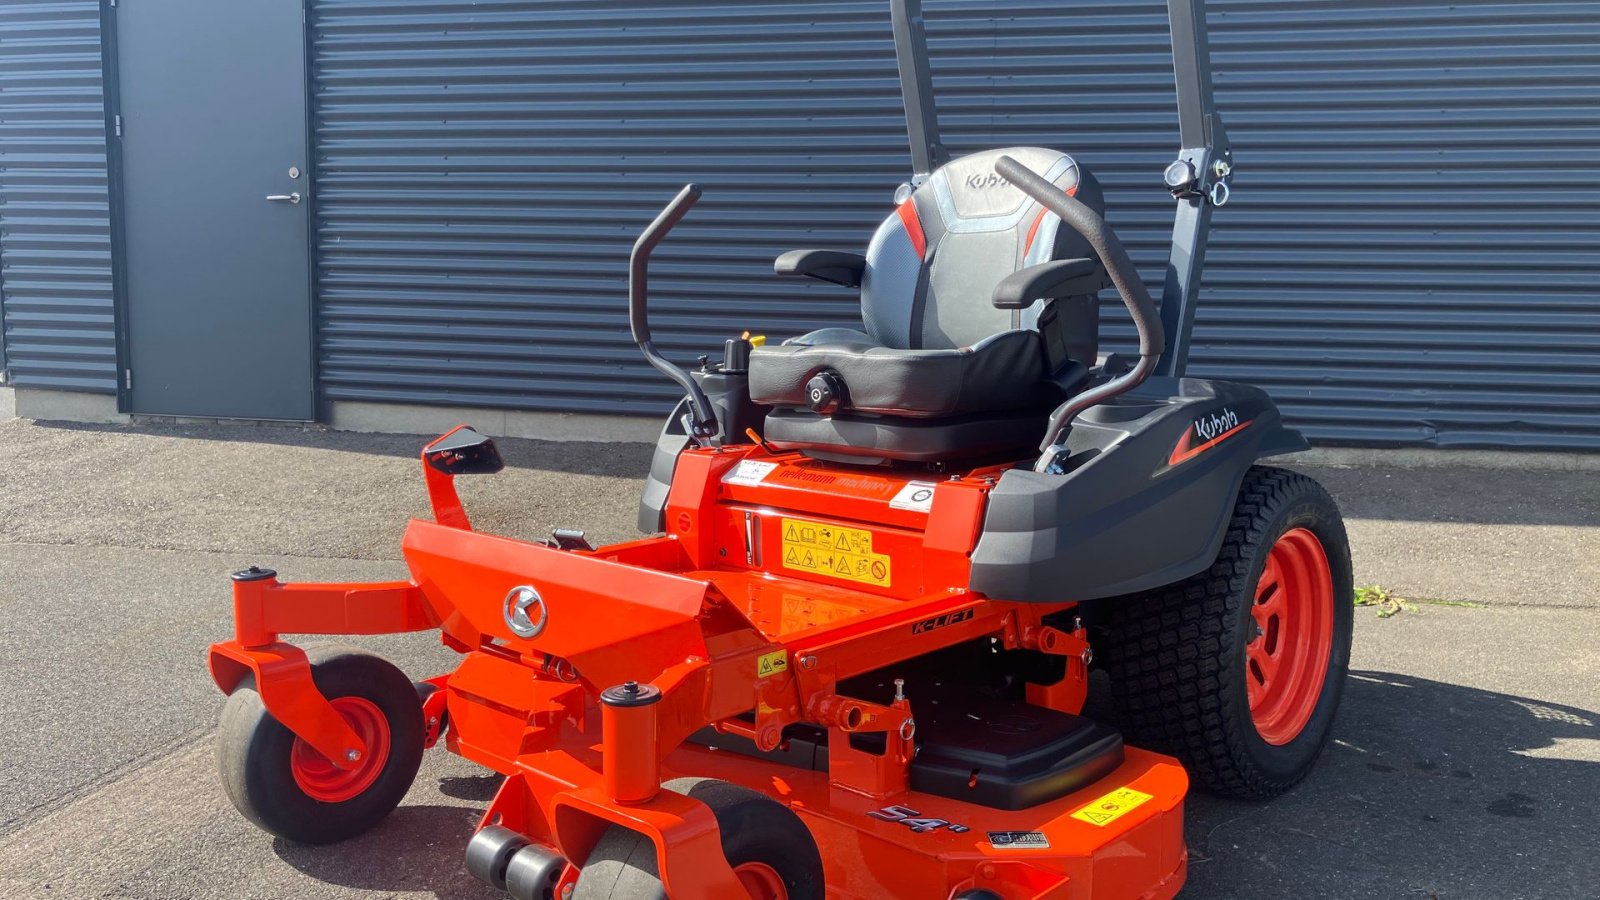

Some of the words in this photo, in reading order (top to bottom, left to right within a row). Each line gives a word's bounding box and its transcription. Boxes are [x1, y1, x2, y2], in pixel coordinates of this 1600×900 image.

[1194, 407, 1239, 440] Kubota
[779, 467, 836, 484] nellemann
[914, 608, 974, 634] K-LIFT
